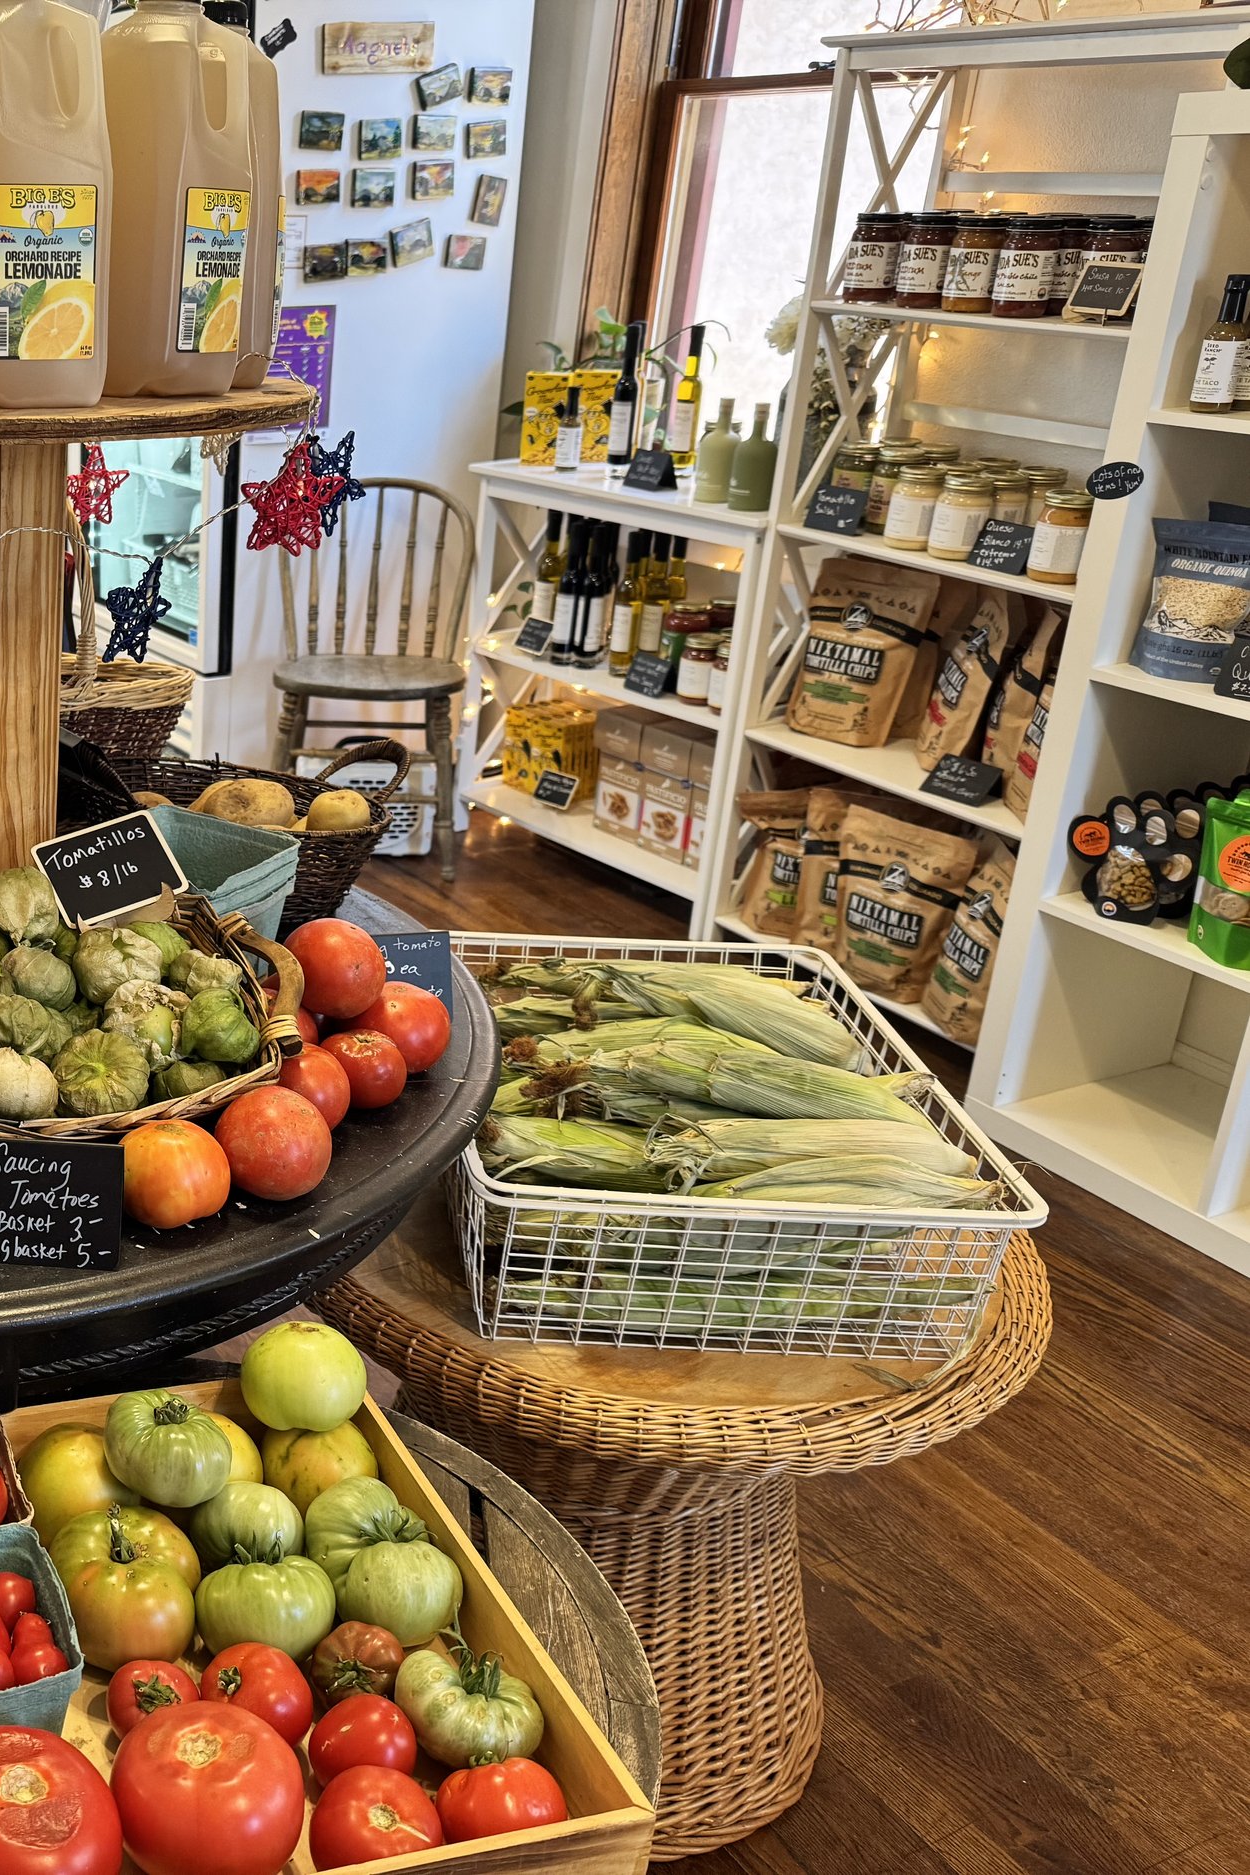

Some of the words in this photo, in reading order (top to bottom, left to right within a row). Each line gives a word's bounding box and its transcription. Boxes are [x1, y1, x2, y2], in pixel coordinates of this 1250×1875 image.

[10, 188, 46, 209] BIG
[48, 188, 76, 210] B'S
[204, 192, 226, 212] BIG
[227, 193, 242, 214] B'S
[24, 235, 64, 250] Organic
[211, 236, 235, 249] Organic
[5, 250, 49, 262] ORCHARD
[50, 251, 82, 262] RECIPE
[197, 251, 226, 262] ORCHARD
[226, 252, 242, 262] RECIPE
[860, 244, 885, 258] SUE'S
[913, 248, 938, 262] SUE'S
[964, 251, 990, 266] SUE'S
[1012, 254, 1040, 268] SUE'S
[4, 263, 82, 280] LEMONADE
[196, 262, 240, 278] LEMONADE
[1114, 466, 1126, 478] of
[986, 521, 1015, 533] Queso
[1171, 558, 1215, 574] ORGANIC
[1213, 566, 1249, 579] QUINOA
[809, 638, 880, 667] NIXTAMAL
[847, 661, 878, 680] CHIPS
[45, 826, 146, 870] Tomatillos
[850, 894, 919, 932] NIXTAMAL
[887, 926, 918, 944] CHIPS
[393, 936, 442, 951] tomato
[400, 965, 422, 976] ea
[10, 1179, 100, 1212] Tomatoes
[14, 1236, 68, 1260] basket
